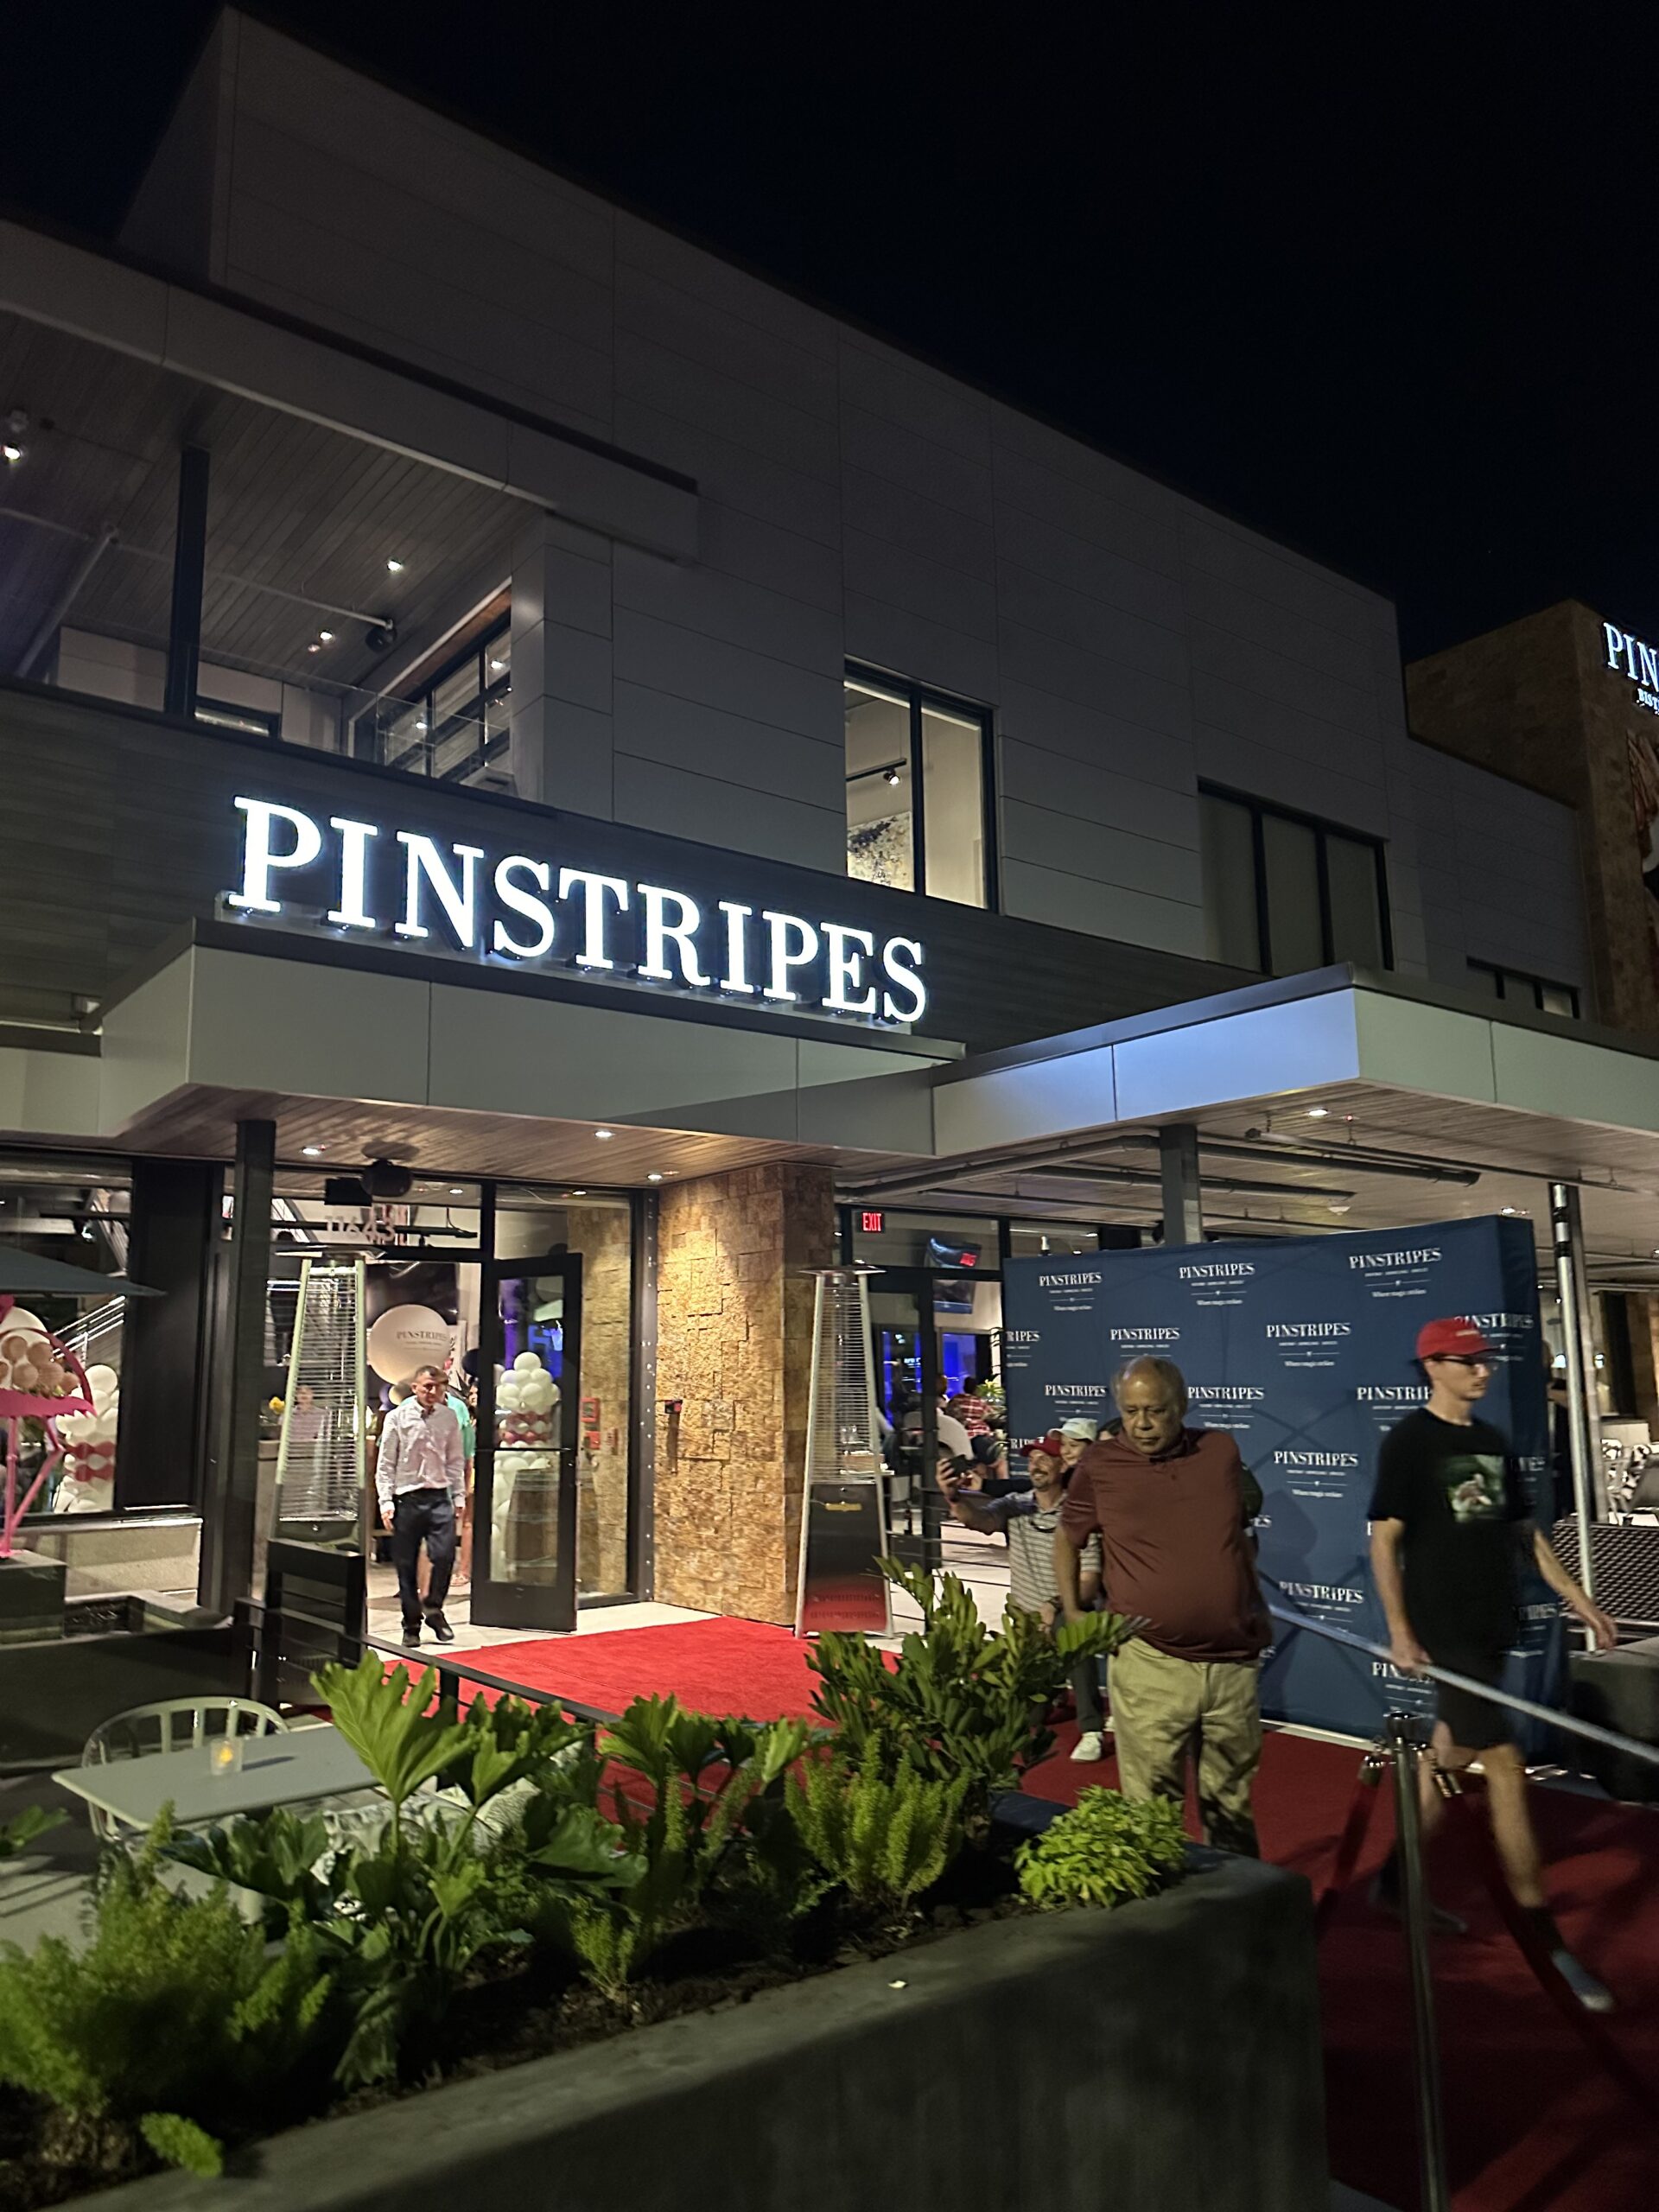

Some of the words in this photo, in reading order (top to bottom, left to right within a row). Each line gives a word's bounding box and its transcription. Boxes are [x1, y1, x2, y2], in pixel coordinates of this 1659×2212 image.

[226, 796, 925, 1024] PINSTRIPES
[862, 1212, 882, 1232] EXIT
[1350, 1247, 1442, 1269] PINSTRIPES
[1179, 1262, 1255, 1279] PINSTRIPES
[1039, 1272, 1103, 1287] PINSTRIPES
[1110, 1327, 1180, 1340] PINSTRIPES
[1266, 1323, 1351, 1338] PINSTRIPES
[1045, 1384, 1107, 1397] PINSTRIPES
[1187, 1386, 1265, 1400] PINSTRIPES
[1274, 1451, 1359, 1466] PINSTRIPES
[1279, 1580, 1364, 1604] PINSTRIPES
